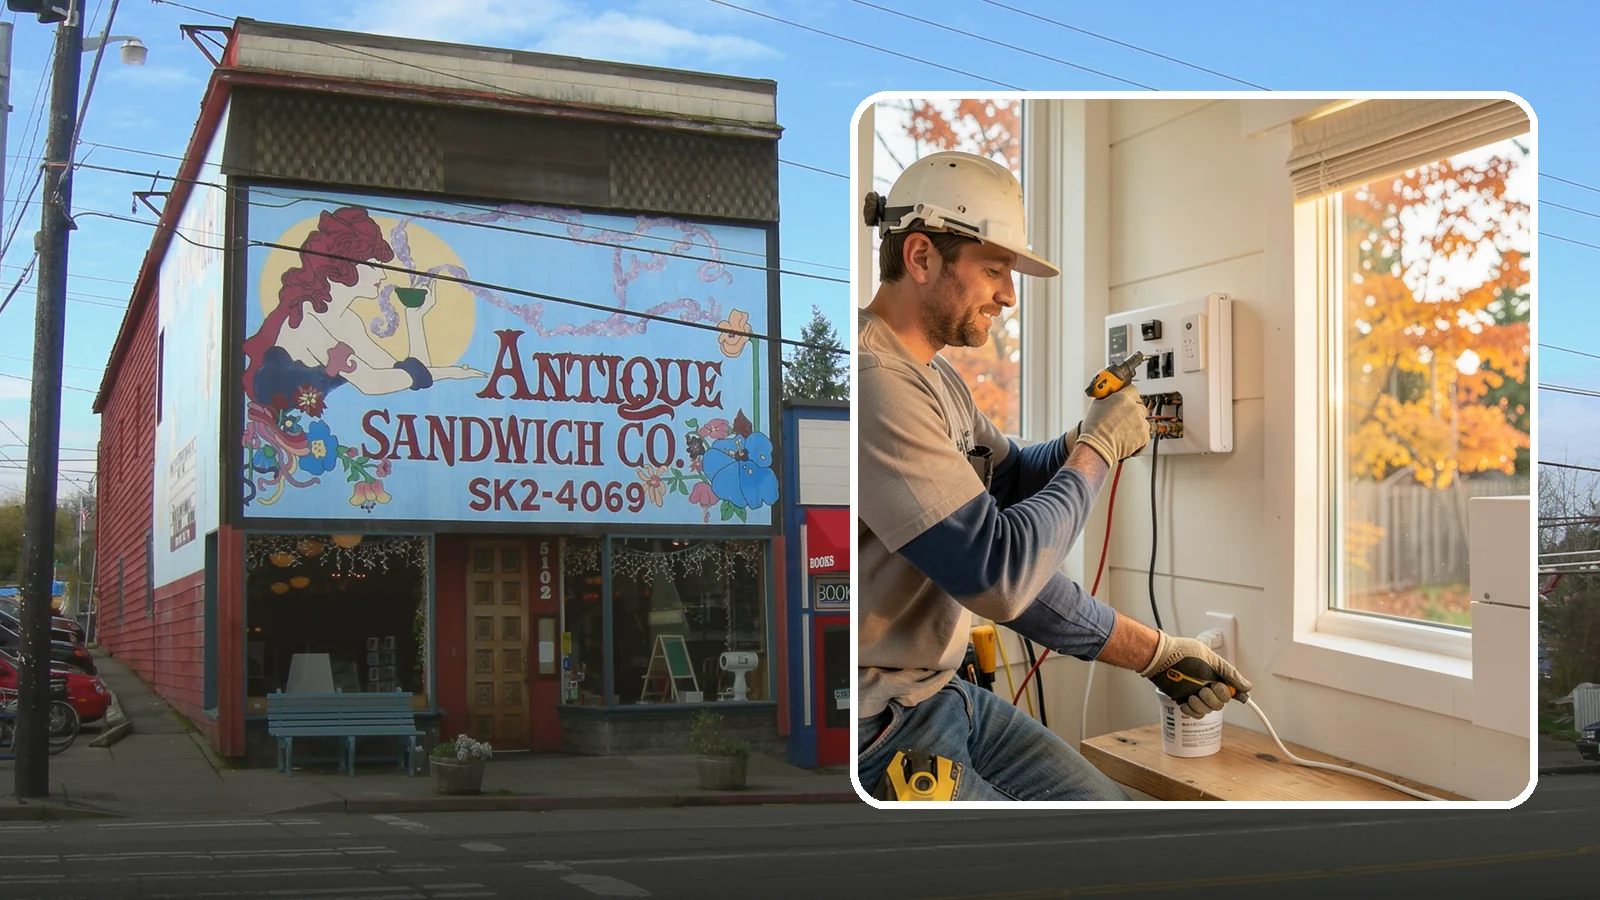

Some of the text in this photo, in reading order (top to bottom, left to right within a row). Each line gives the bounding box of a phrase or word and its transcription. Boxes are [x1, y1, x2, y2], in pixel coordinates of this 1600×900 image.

[361, 408, 685, 469] SANDWICH CO.
[468, 477, 646, 513] SK2-4069
[540, 542, 551, 600] 5102
[809, 555, 835, 569] BOOKS
